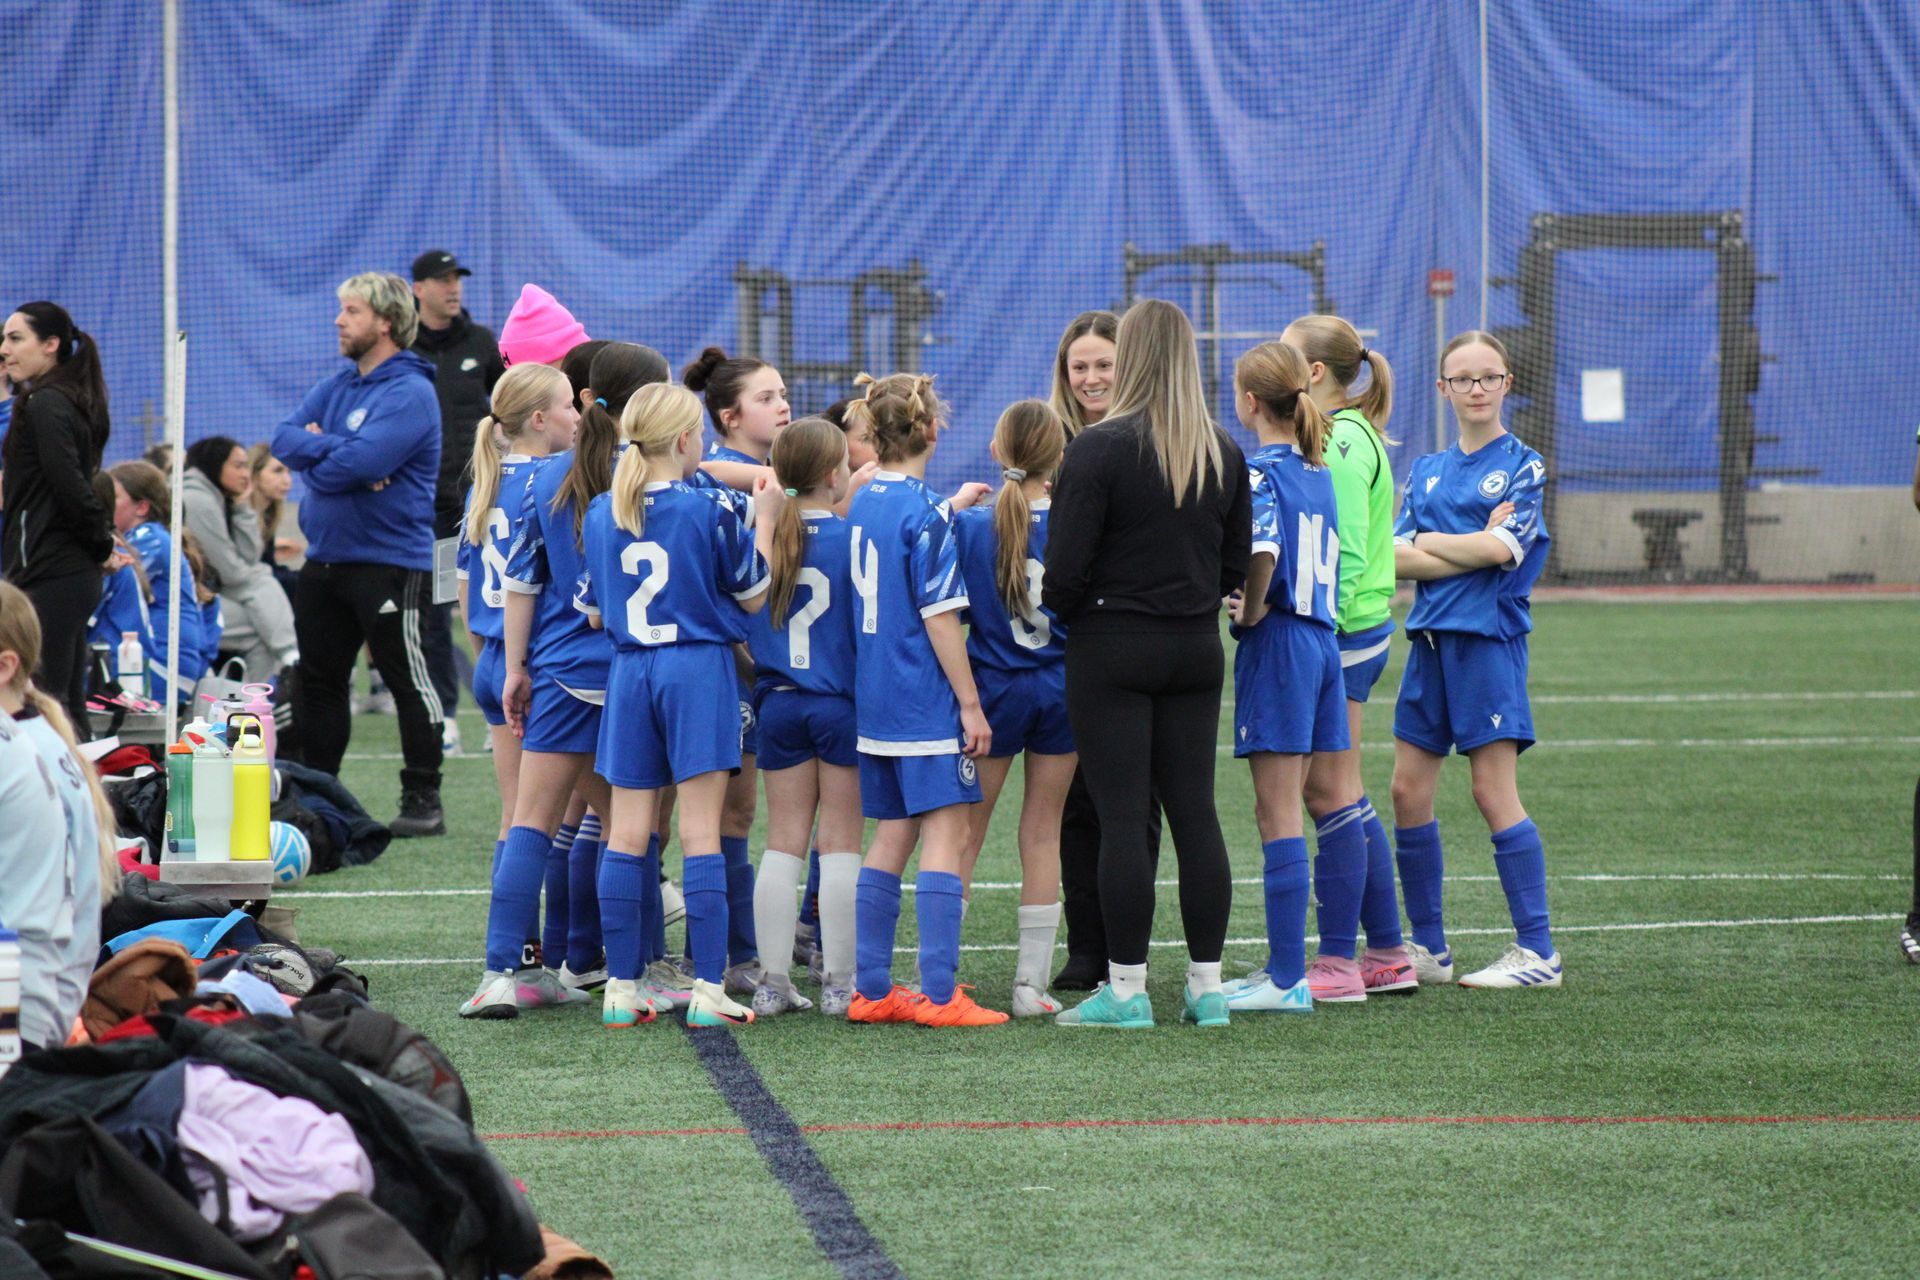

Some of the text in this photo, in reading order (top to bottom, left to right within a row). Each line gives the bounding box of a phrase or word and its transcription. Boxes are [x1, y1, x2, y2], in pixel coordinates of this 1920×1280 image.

[481, 507, 510, 608] 6
[620, 541, 678, 644] 2
[850, 525, 879, 634] 4
[1295, 511, 1340, 619] 14
[788, 566, 831, 669] 7
